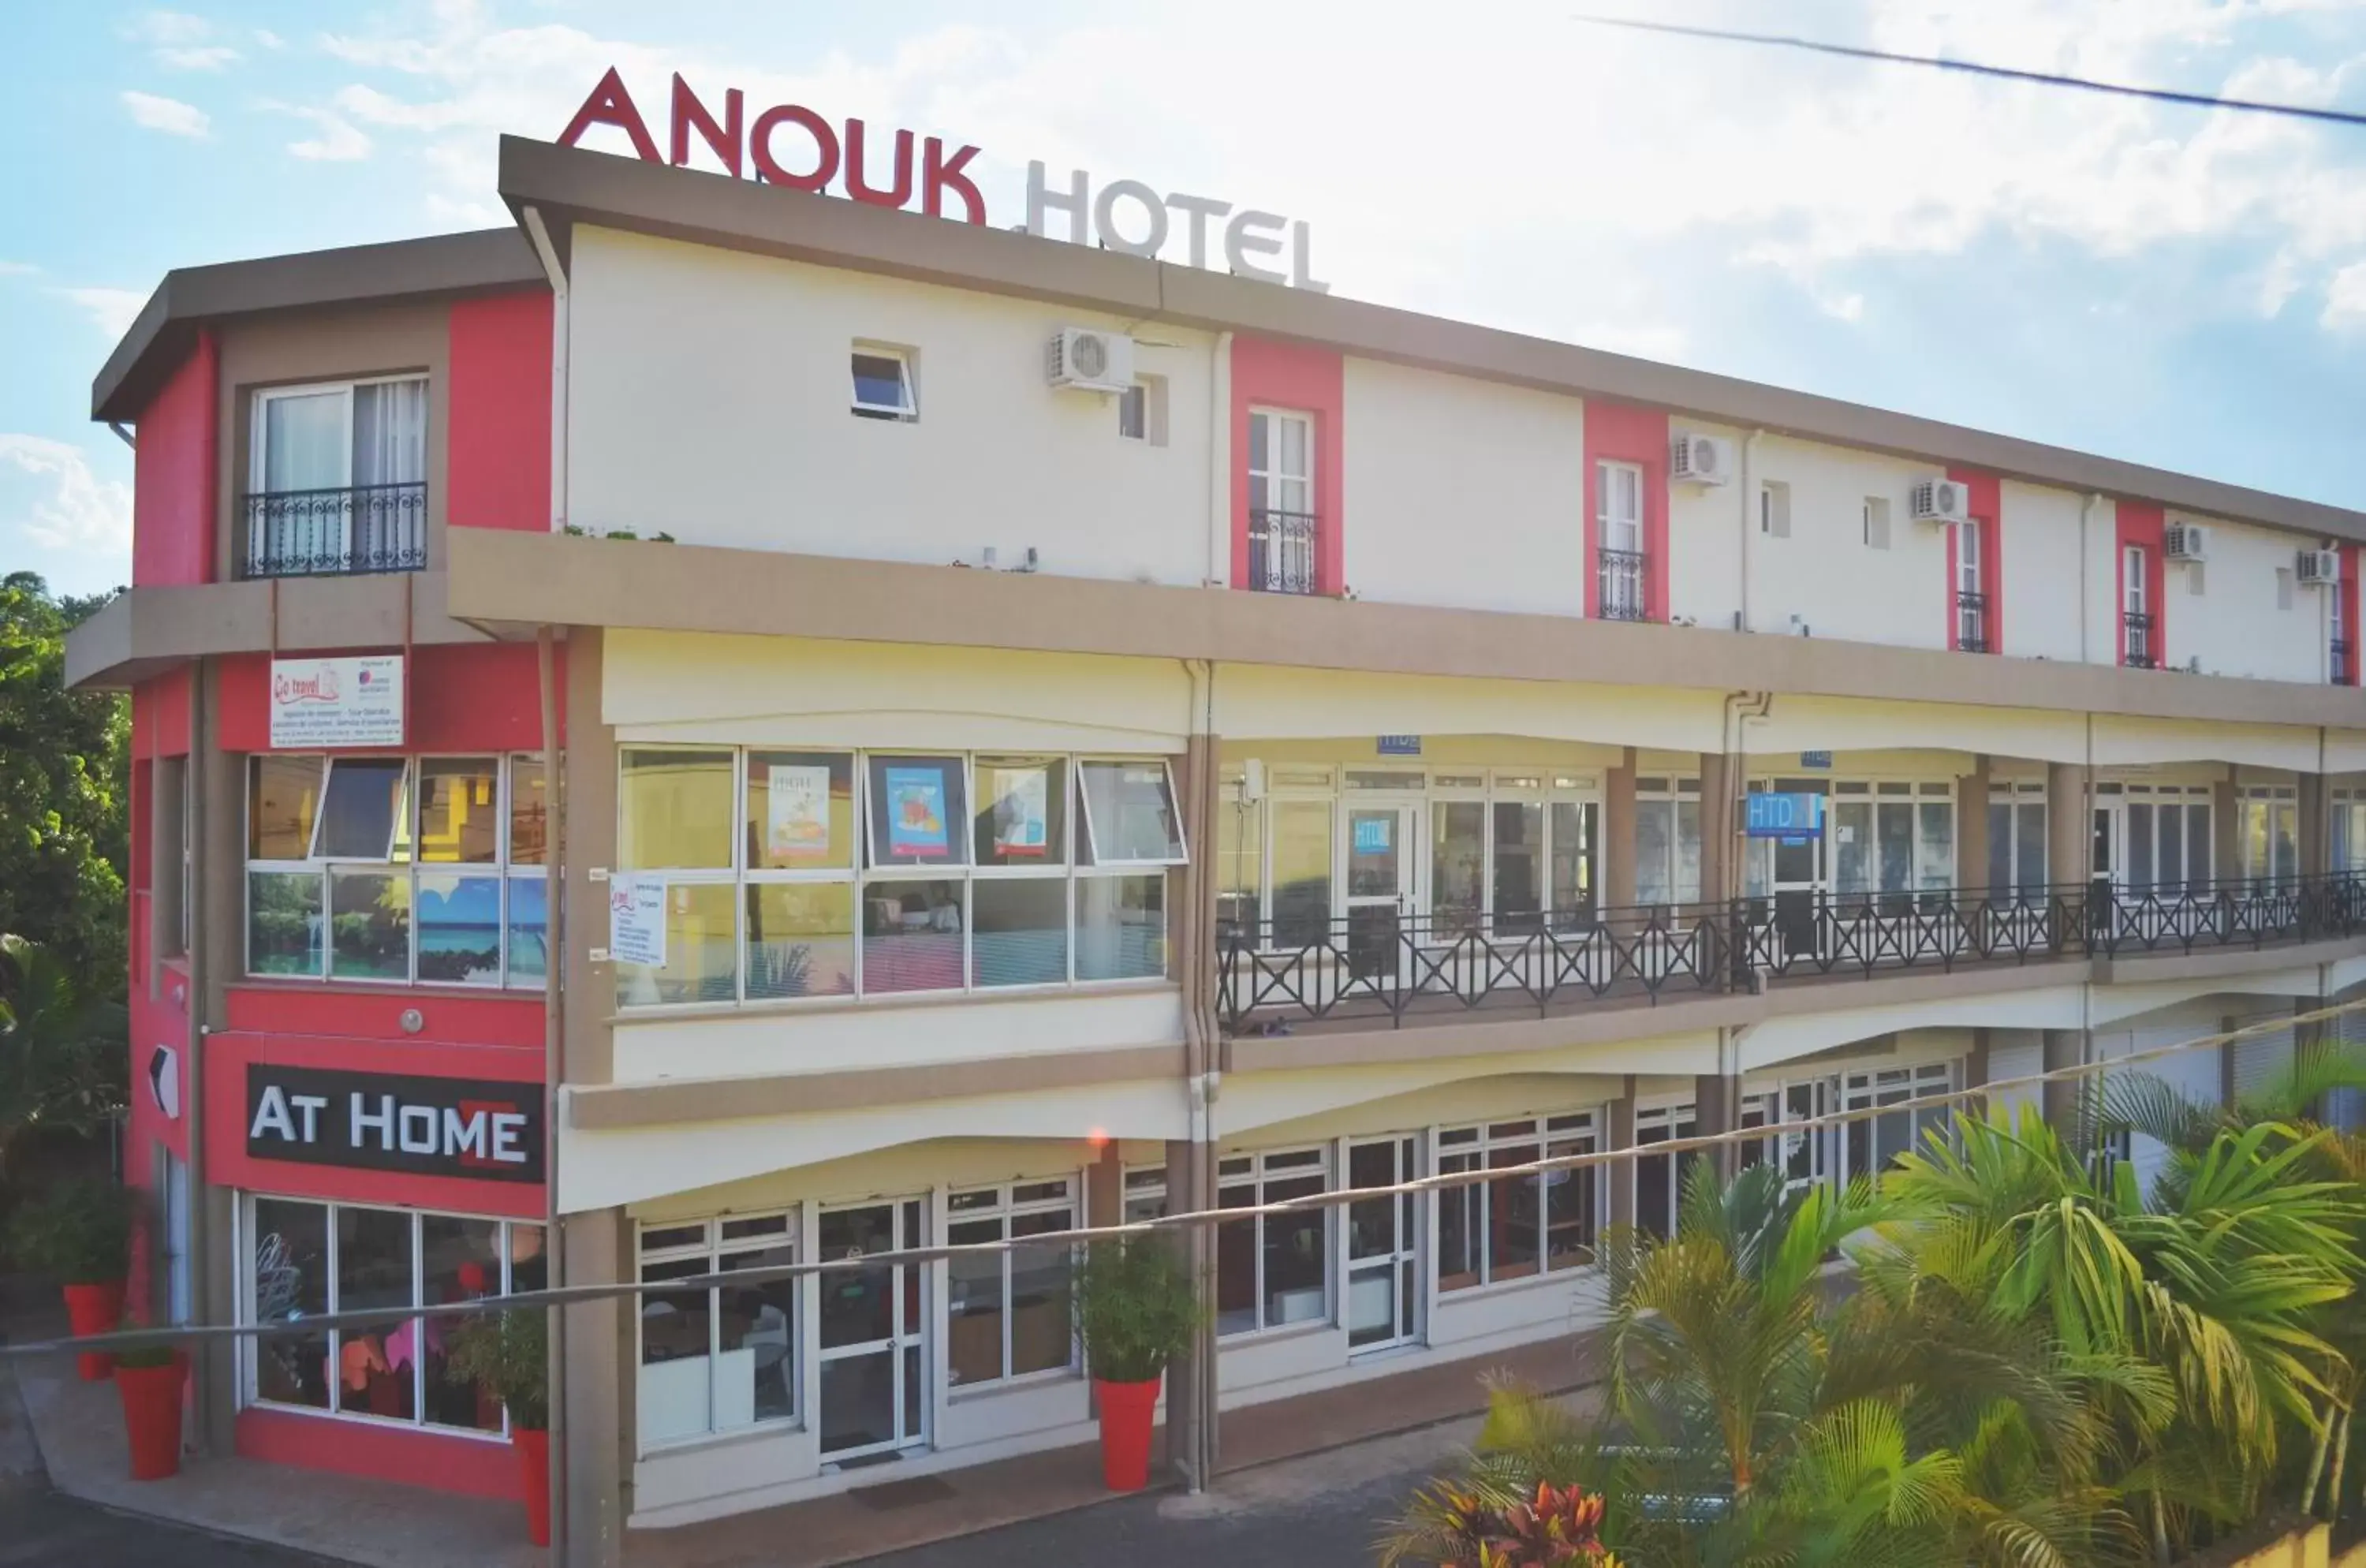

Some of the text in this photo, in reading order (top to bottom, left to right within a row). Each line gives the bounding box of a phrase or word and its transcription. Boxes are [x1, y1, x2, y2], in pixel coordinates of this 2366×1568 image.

[557, 65, 1330, 294] ANOUK HOTEL
[1750, 795, 1792, 827] HTD
[350, 1092, 527, 1163] HOME
